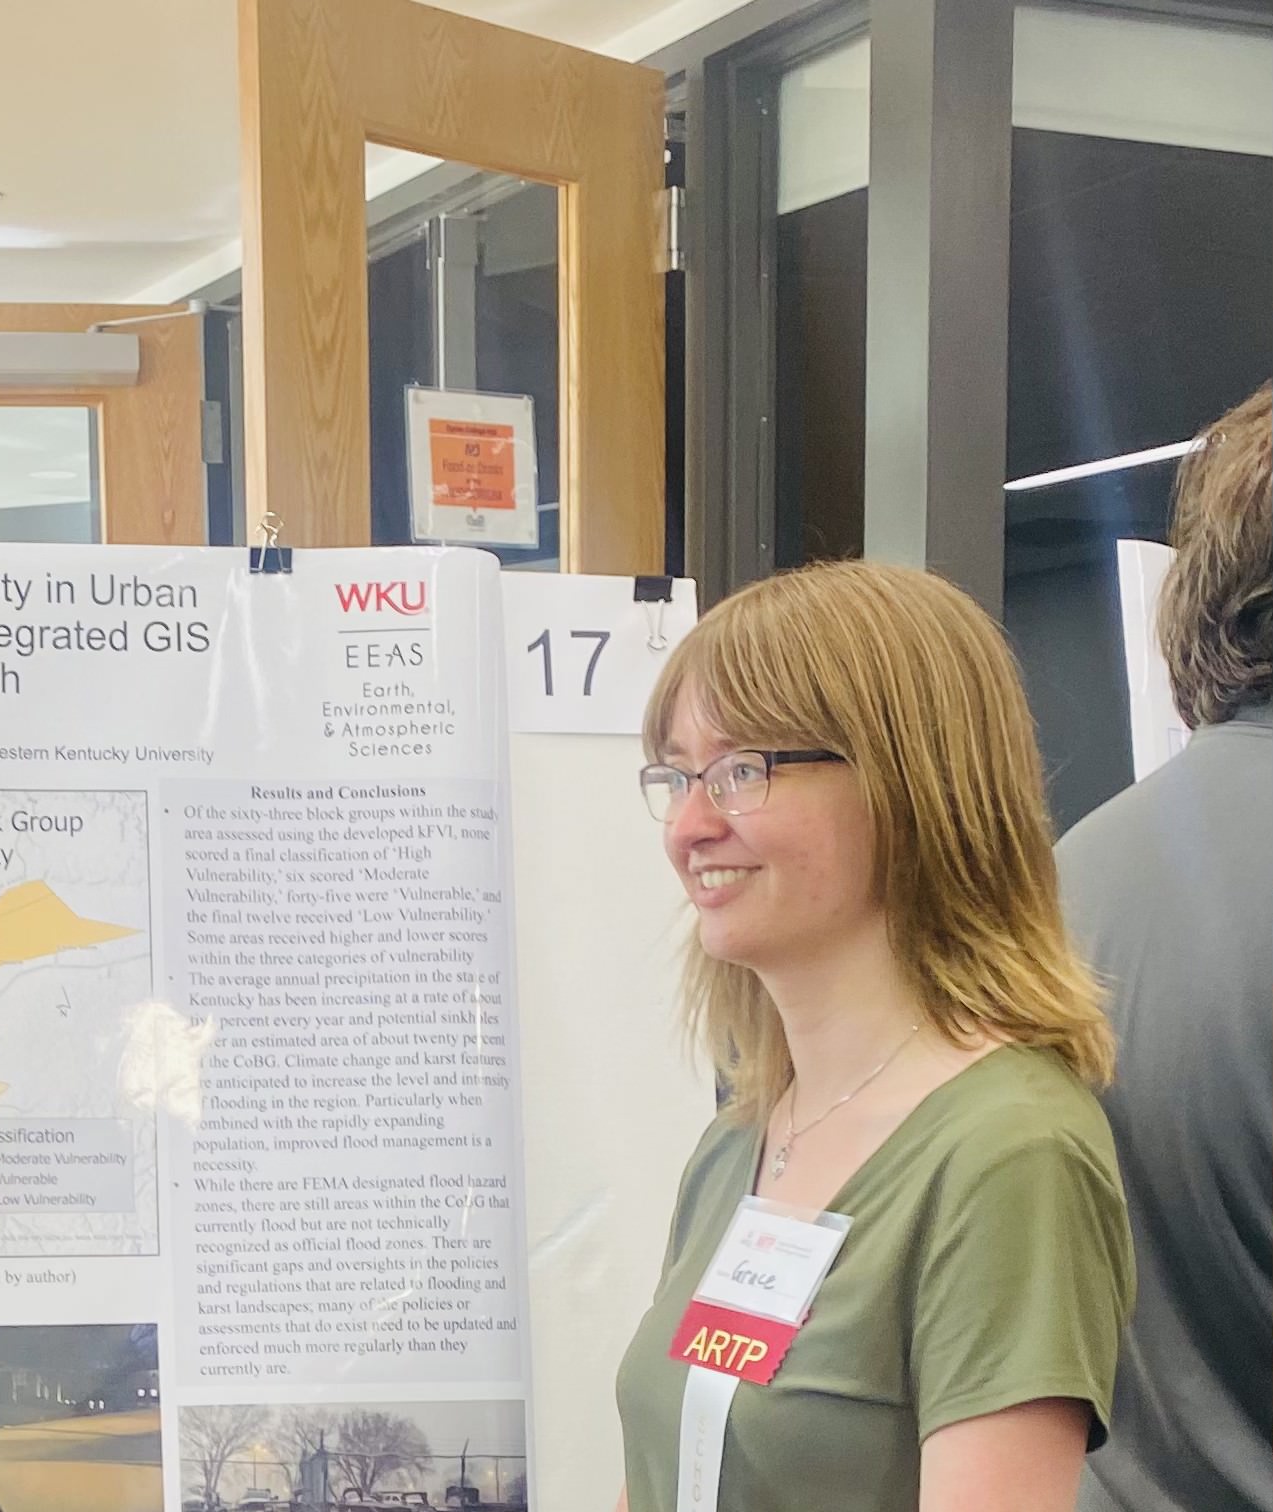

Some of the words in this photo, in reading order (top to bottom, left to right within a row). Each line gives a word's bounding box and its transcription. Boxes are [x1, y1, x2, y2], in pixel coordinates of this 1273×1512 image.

[45, 572, 75, 604] in
[90, 573, 198, 608] Urban
[335, 581, 425, 616] WKU
[142, 621, 210, 653] GIS
[527, 629, 611, 697] 17
[362, 681, 415, 699] Earth,
[322, 700, 455, 717] Environmental,
[323, 723, 335, 738] &
[341, 721, 455, 739] Atmospheric
[55, 745, 129, 764] Kentucky
[135, 746, 214, 765] University
[348, 741, 433, 758] Sciences
[250, 786, 303, 801] Results
[307, 786, 333, 800] and
[337, 784, 427, 800] Conclusions
[11, 810, 84, 837] Group
[183, 806, 204, 820] Of
[206, 806, 226, 820] the
[229, 806, 304, 824] sixty-three
[306, 806, 345, 821] block
[348, 806, 396, 825] groups
[399, 804, 443, 819] within
[446, 804, 467, 819] the
[184, 828, 213, 841] area
[216, 826, 274, 842] assessed
[277, 827, 314, 845] using
[318, 826, 339, 841] the
[342, 825, 414, 845] developed
[461, 827, 491, 841] none
[185, 847, 229, 862] scored
[233, 850, 241, 862] a
[245, 847, 276, 862] final
[279, 846, 370, 862] classification
[373, 846, 388, 861] of
[285, 868, 305, 883] six
[309, 868, 354, 883] scored
[286, 888, 352, 906] forty-five
[355, 889, 388, 903] were
[482, 889, 502, 903] and
[187, 910, 208, 924] the
[211, 909, 242, 924] final
[245, 909, 292, 924] twelve
[295, 909, 353, 924] received
[187, 930, 226, 945] Some
[229, 931, 264, 945] areas
[268, 930, 326, 945] received
[329, 929, 373, 947] higher
[377, 929, 403, 943] and
[406, 929, 446, 943] lower
[448, 930, 489, 943] scores
[187, 951, 231, 966] within
[234, 951, 256, 965] the
[259, 951, 294, 965] three
[297, 952, 367, 969] categories
[370, 950, 386, 964] of
[55, 1152, 127, 1166] Vulnerability
[193, 1178, 236, 1192] While
[239, 1178, 274, 1192] there
[277, 1179, 299, 1192] are
[302, 1177, 349, 1191] FEMA
[352, 1176, 426, 1193] designated
[429, 1175, 464, 1189] flood
[23, 1194, 97, 1206] Vulnerability
[5, 1270, 21, 1287] by
[27, 1269, 77, 1287] author)
[682, 1326, 769, 1372] ARTP
